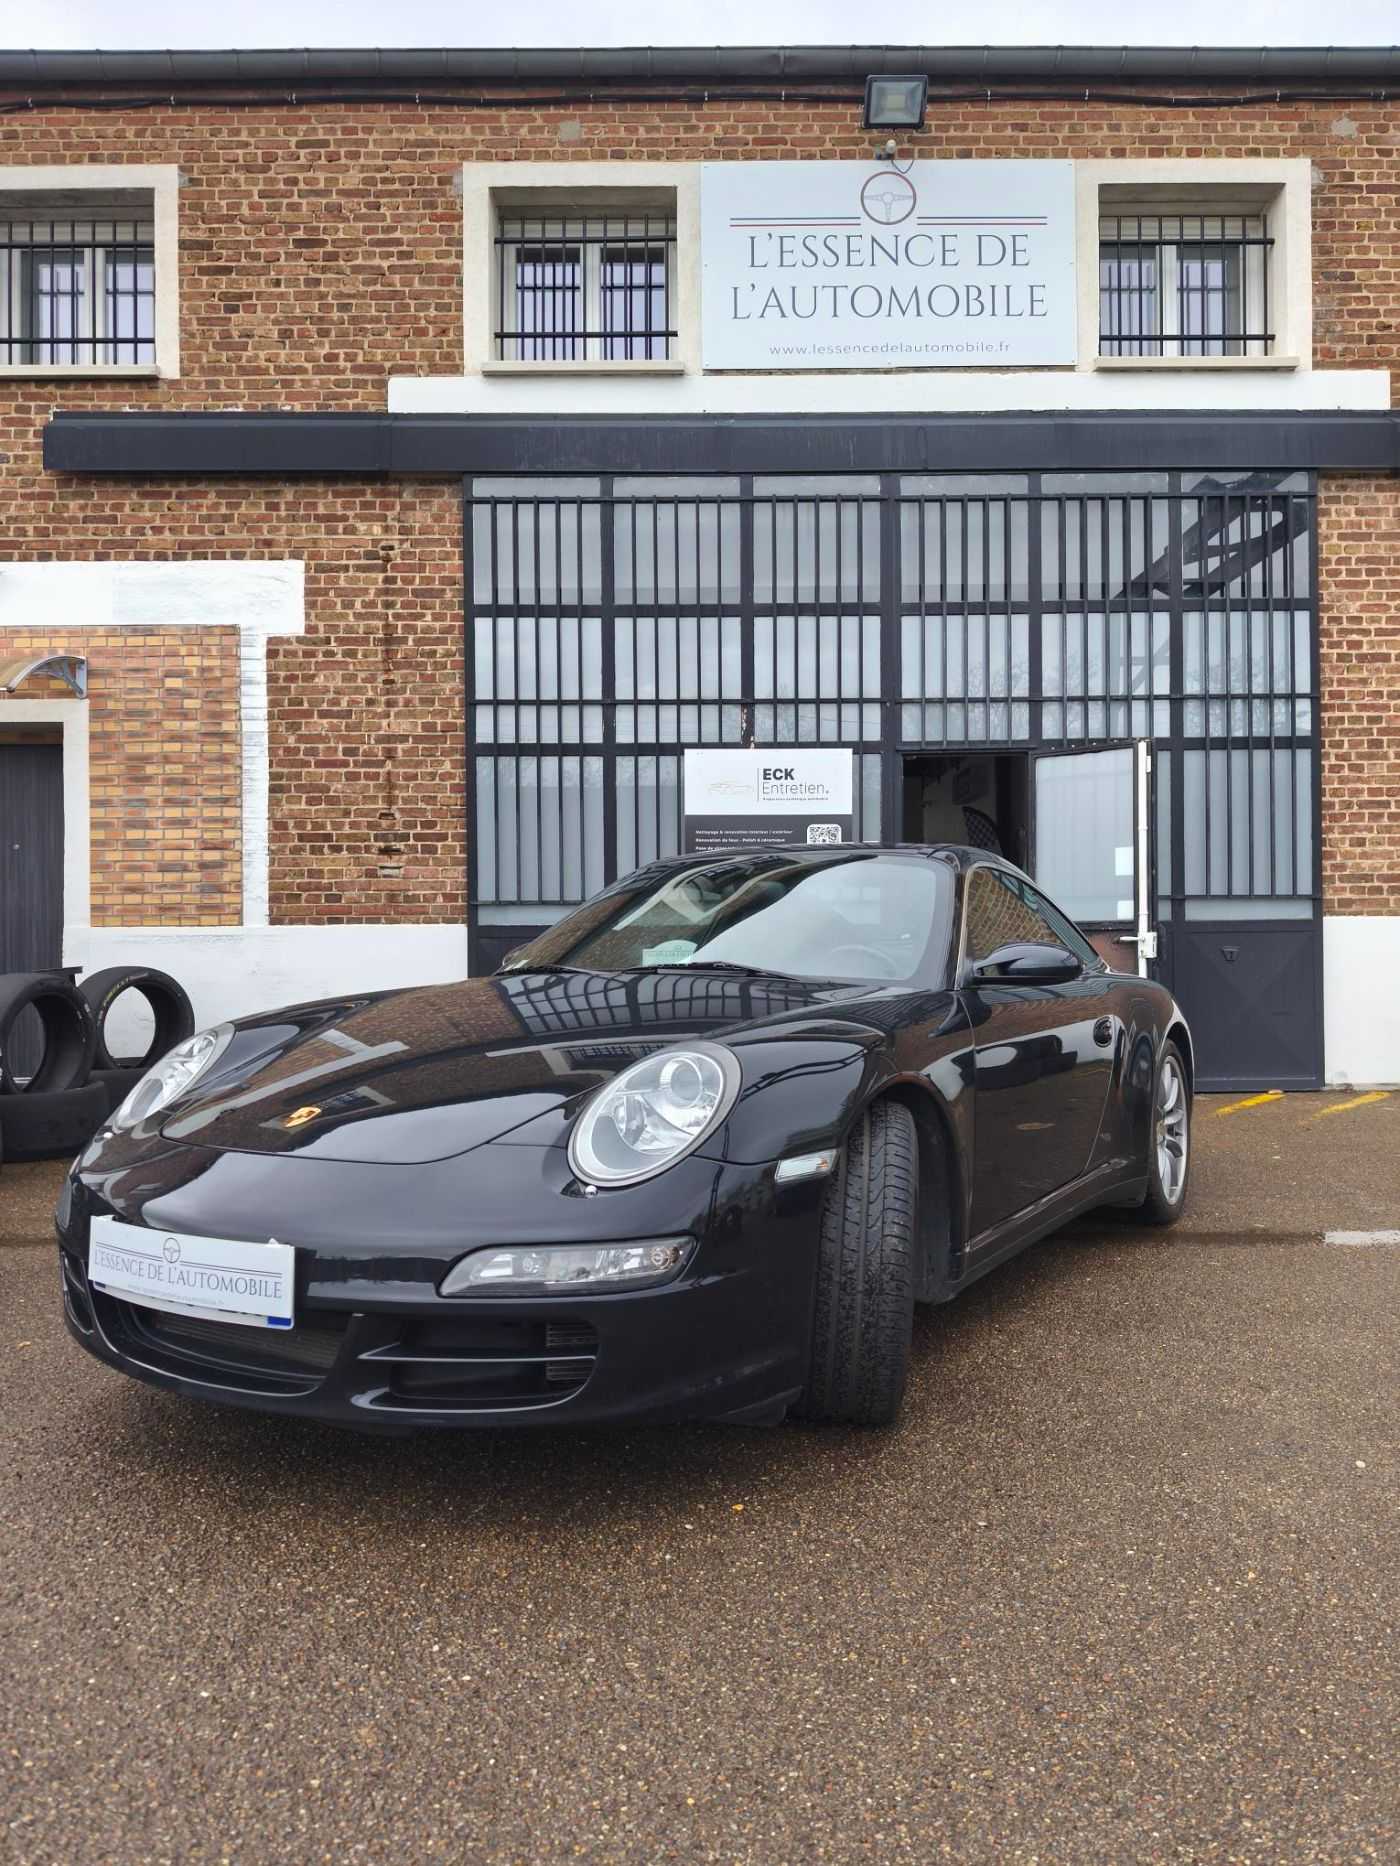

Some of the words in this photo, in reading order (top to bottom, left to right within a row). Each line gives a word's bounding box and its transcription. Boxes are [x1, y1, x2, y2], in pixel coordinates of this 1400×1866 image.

[748, 233, 960, 269] L'ESSENCE
[976, 233, 1031, 267] DE
[731, 284, 1048, 320] L'AUTOMOBILE
[768, 341, 1012, 356] www.lessencedelautomobile.fr
[762, 768, 796, 781] ECK
[762, 781, 830, 795] Entretien.
[94, 1249, 145, 1278] L'ESSENCE
[147, 1263, 164, 1282] DE
[167, 1265, 283, 1299] L'AUTOMOBILE
